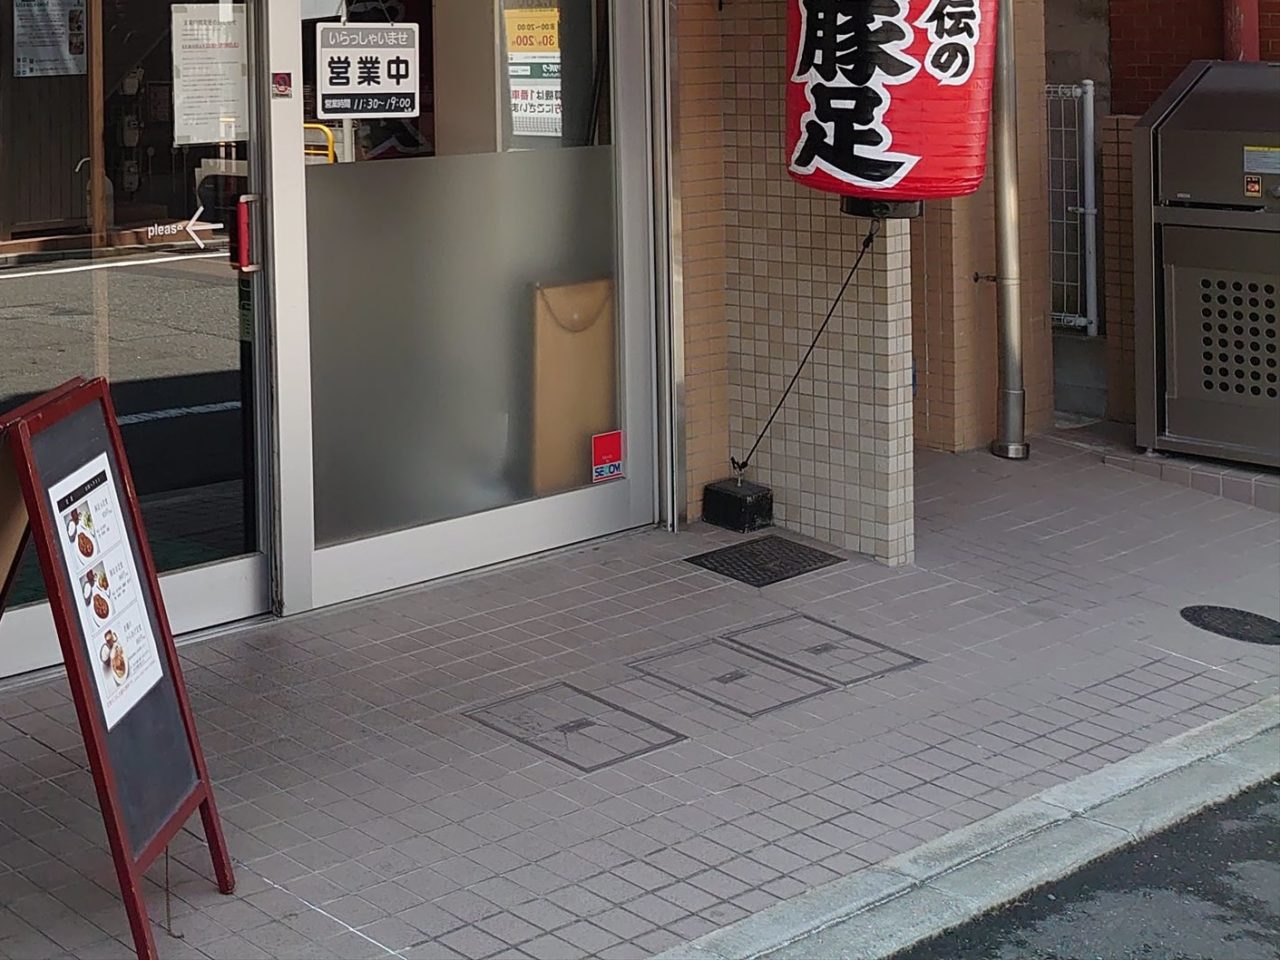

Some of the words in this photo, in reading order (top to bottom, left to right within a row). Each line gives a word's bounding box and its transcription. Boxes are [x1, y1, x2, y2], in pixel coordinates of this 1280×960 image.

[328, 31, 409, 46] いらっしゃいませ
[327, 55, 410, 87] 営業中
[594, 463, 621, 477] SECOM
